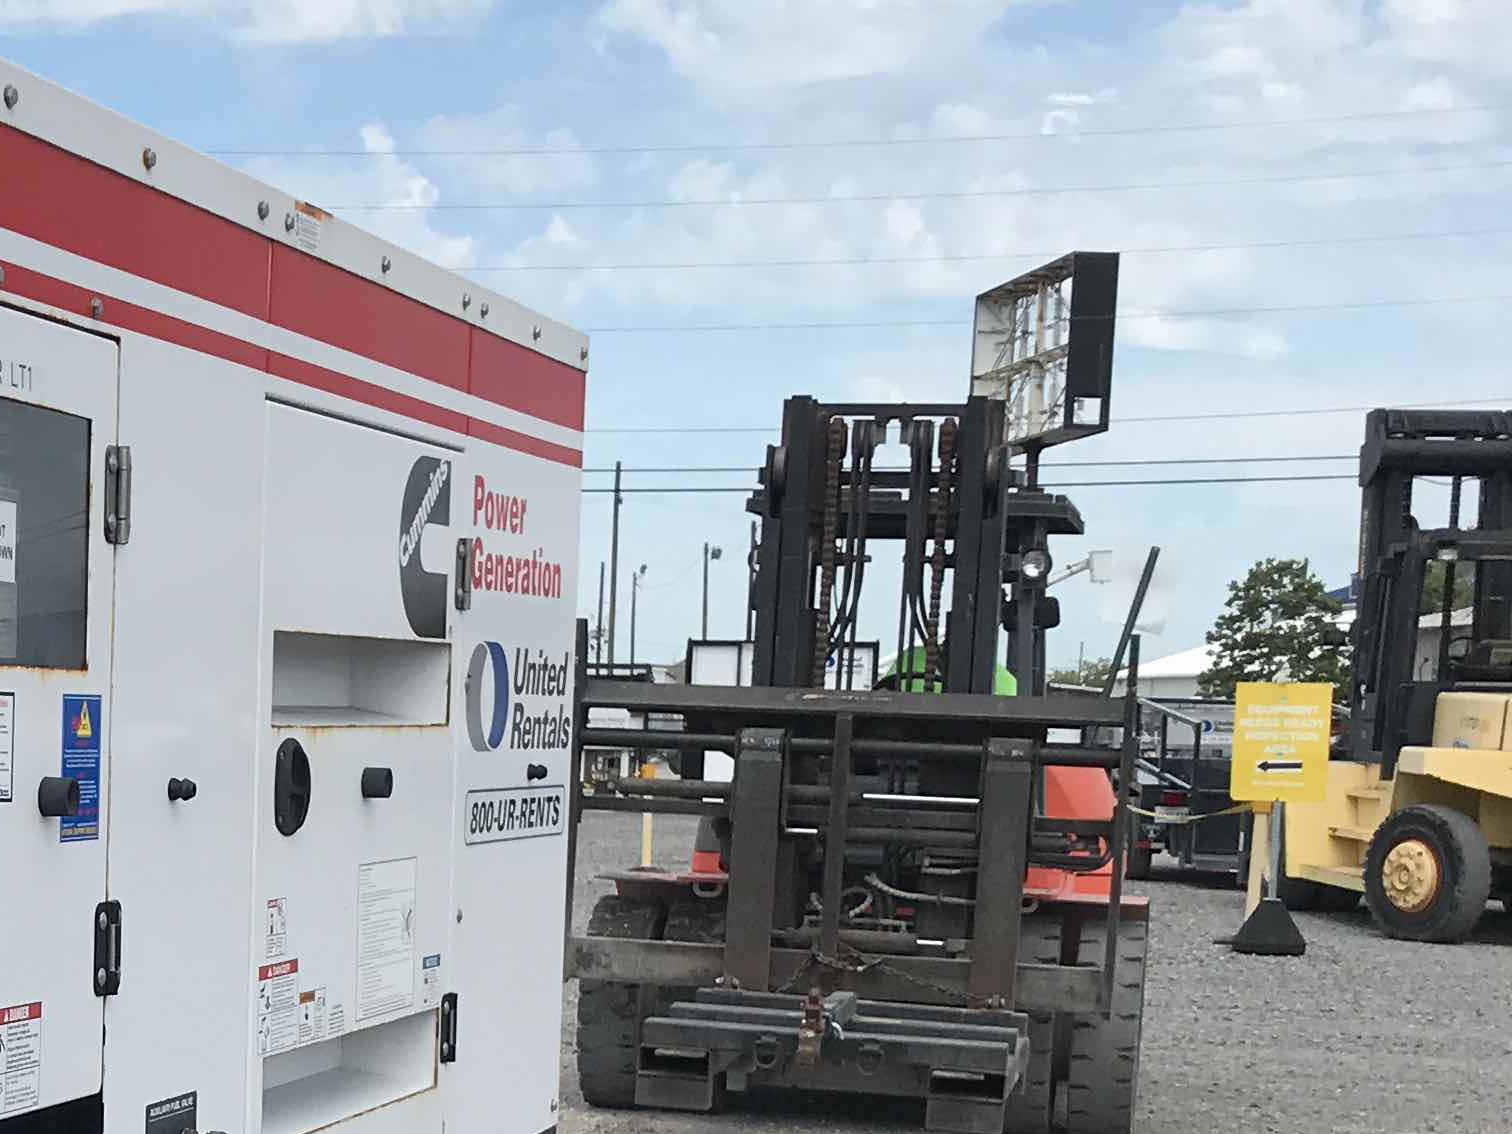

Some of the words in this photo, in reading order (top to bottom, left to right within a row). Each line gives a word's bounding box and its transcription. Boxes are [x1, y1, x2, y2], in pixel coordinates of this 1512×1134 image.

[10, 361, 32, 393] LT1
[399, 459, 449, 568] Cummins
[473, 474, 528, 535] Power
[471, 536, 561, 599] Generation
[513, 647, 569, 697] United
[510, 702, 571, 750] Rentals
[470, 794, 561, 835] 800-UR-RENTS
